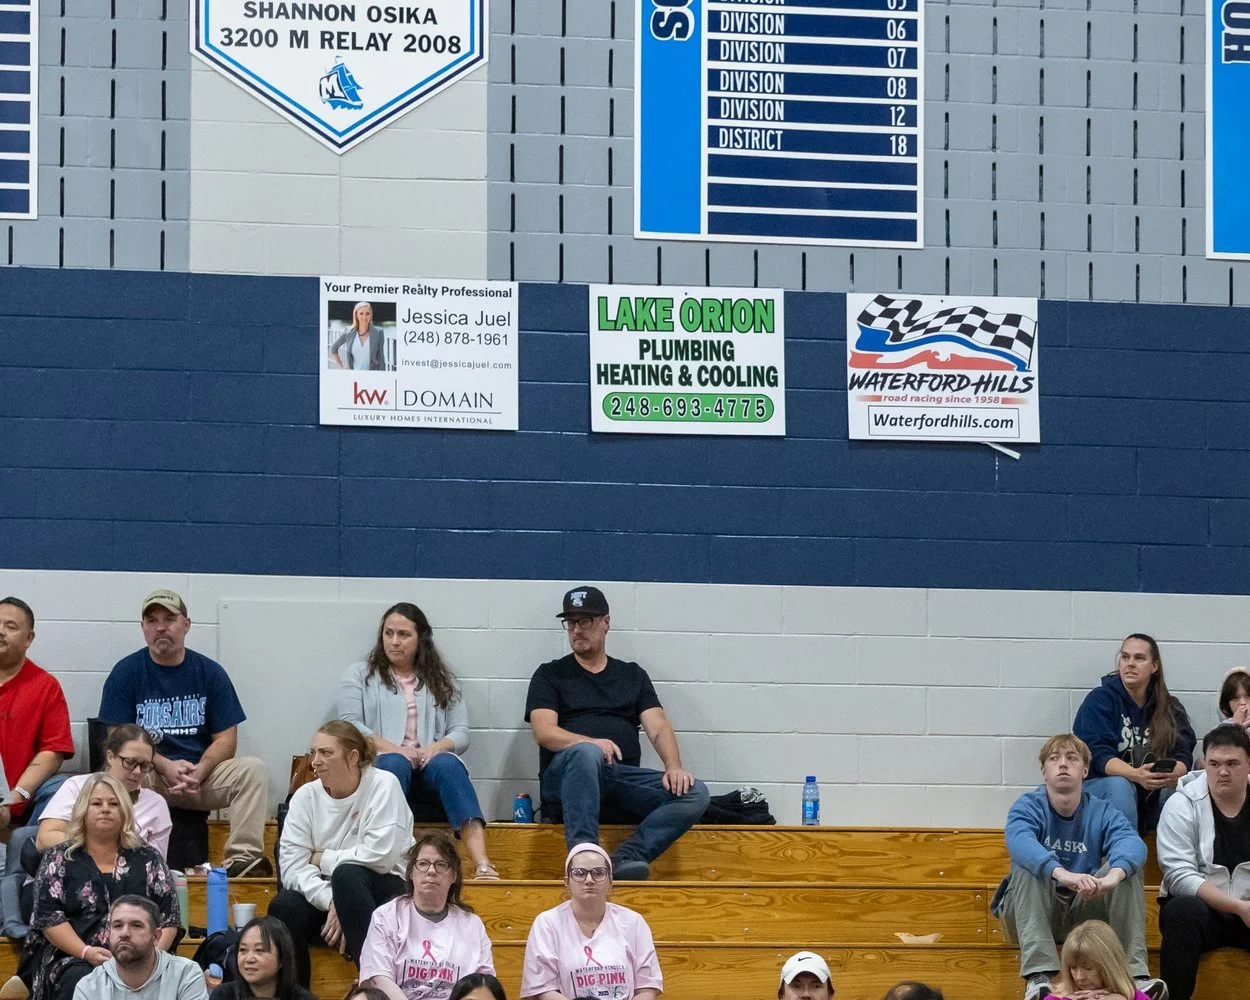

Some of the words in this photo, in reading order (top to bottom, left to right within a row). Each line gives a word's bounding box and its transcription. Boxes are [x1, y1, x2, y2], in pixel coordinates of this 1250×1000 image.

[243, 0, 356, 22] SHANNON
[366, 5, 438, 25] OSIKA
[719, 12, 785, 35] DIVISION
[886, 19, 907, 40] 06
[219, 28, 279, 48] 3200
[289, 30, 309, 49] M
[320, 31, 393, 52] RELAY
[402, 34, 462, 54] 2008
[719, 41, 785, 64] DIVISION
[886, 48, 907, 68] 07
[719, 70, 785, 93] DIVISION
[886, 77, 907, 98] 08
[719, 99, 785, 121] DIVISION
[889, 106, 906, 126] 12
[718, 128, 784, 150] DISTRICT
[889, 135, 907, 156] 18
[324, 282, 351, 293] Your
[354, 283, 399, 296] Premier
[402, 285, 438, 298] Realty
[441, 286, 513, 298] Professional
[402, 308, 468, 326] Jessica
[474, 310, 511, 327] Juel
[597, 296, 674, 332] LAKE
[679, 297, 775, 333] ORION
[403, 331, 440, 347] (248)
[444, 331, 508, 346] 878-1961
[638, 339, 735, 362] PLUMBING
[401, 359, 512, 370] invest@jessicajuel.com
[596, 363, 673, 386] HEATING
[678, 365, 692, 386] &
[697, 365, 778, 388] COOLING
[353, 381, 388, 405] kw
[849, 370, 972, 394] WATERFORD
[970, 372, 1035, 396] HILLS
[404, 390, 493, 408] DOMAIN
[610, 396, 766, 418] 248-693-4775
[883, 394, 908, 402] road
[910, 395, 943, 405] racing
[945, 395, 972, 404] since
[975, 396, 1000, 404] 1958
[353, 413, 386, 421] LUXURY
[424, 416, 493, 425] INTERNATIONAL
[873, 413, 1014, 430] Waterfordhills.com
[135, 697, 207, 729] CORSAIRS
[408, 965, 428, 980] DIG
[430, 968, 454, 982] PNK
[576, 974, 596, 988] DIG
[598, 972, 626, 985] PINK
